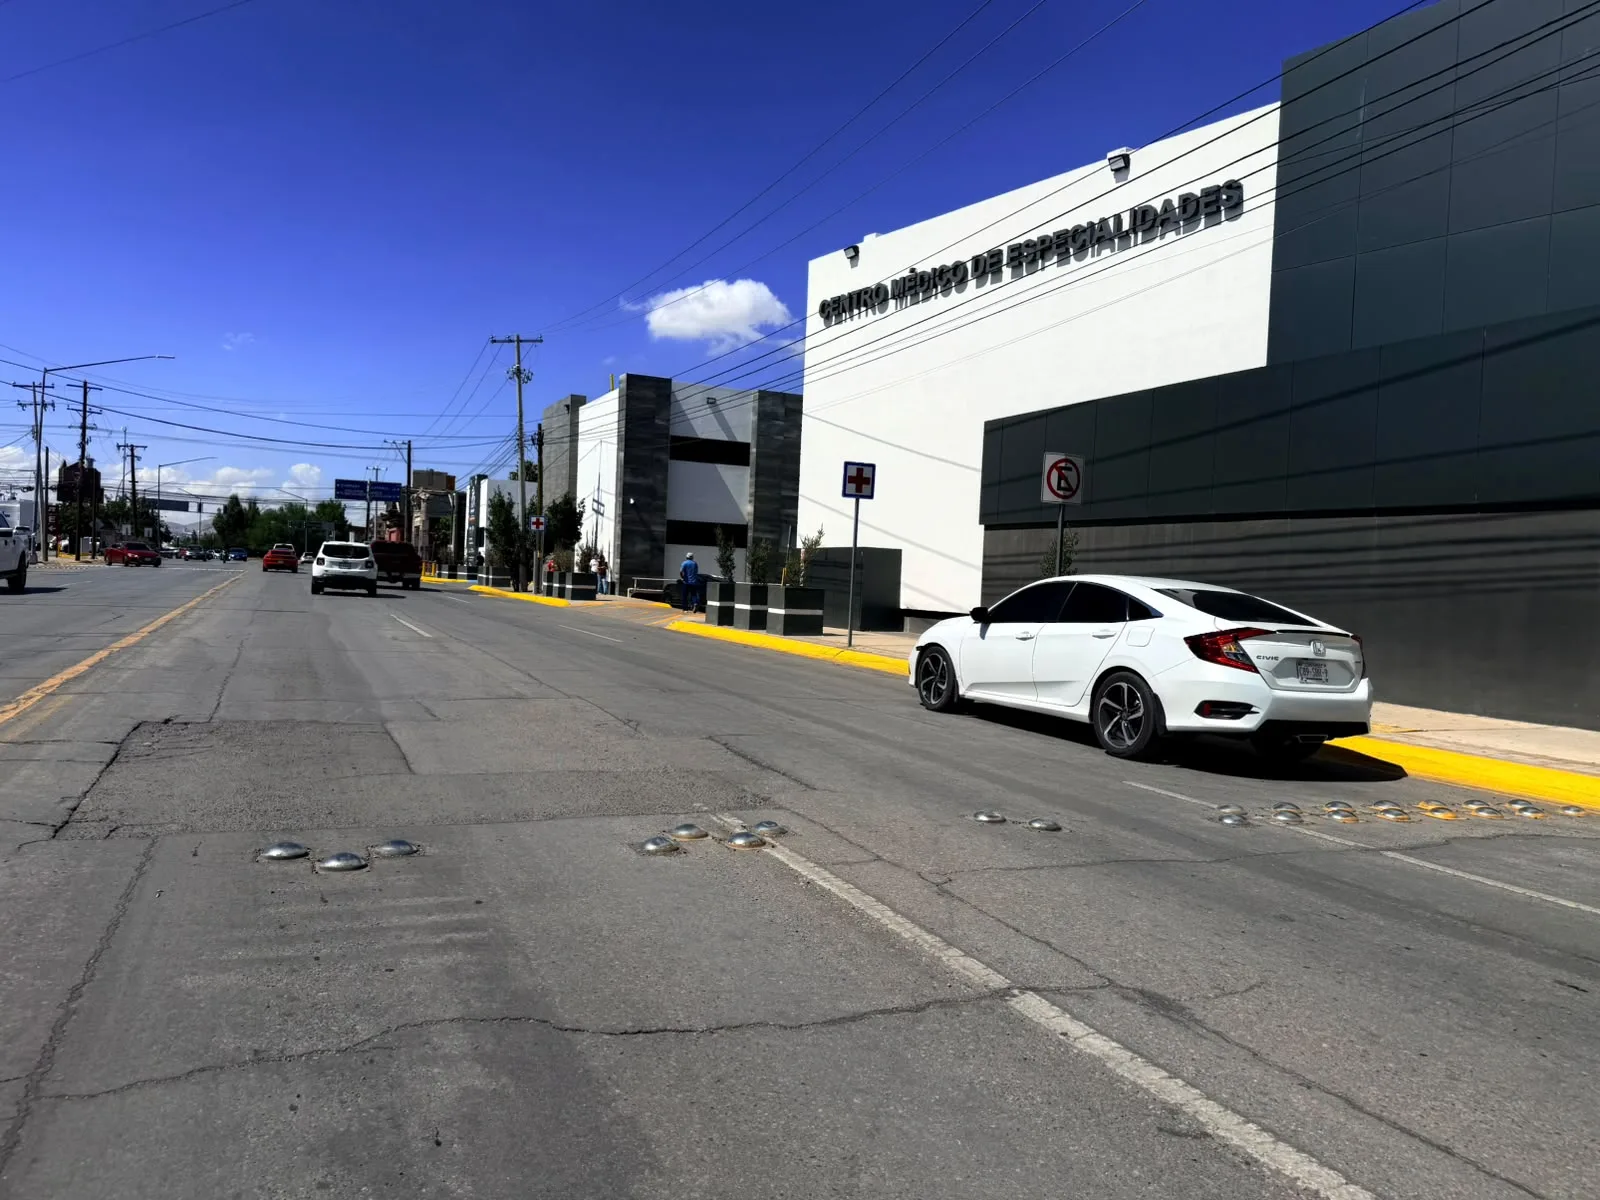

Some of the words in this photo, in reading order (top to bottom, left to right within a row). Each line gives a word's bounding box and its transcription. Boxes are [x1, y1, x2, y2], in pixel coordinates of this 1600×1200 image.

[819, 283, 889, 318] CENTRO
[890, 267, 968, 300] MÉDICO
[970, 248, 1005, 280] DE
[1006, 180, 1243, 268] ESPECIALIDADES
